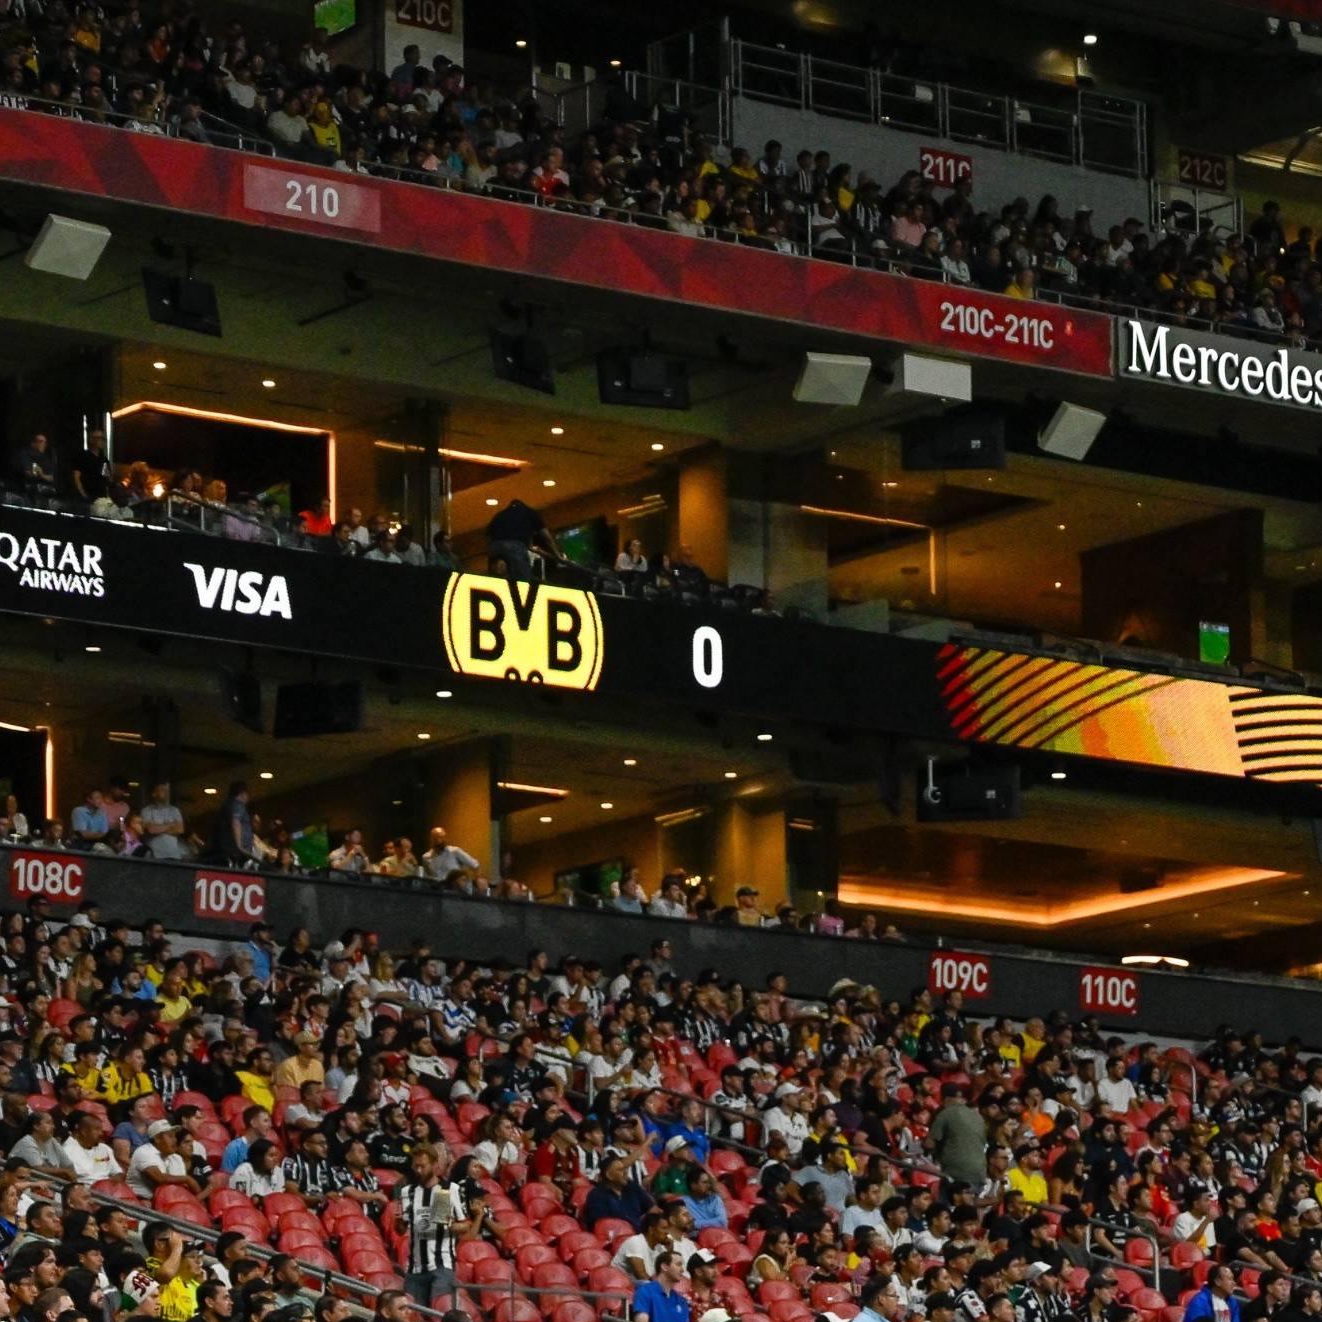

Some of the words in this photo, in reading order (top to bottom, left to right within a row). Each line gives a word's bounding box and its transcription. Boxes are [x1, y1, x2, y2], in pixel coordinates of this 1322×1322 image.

[1181, 156, 1225, 186] 212C
[285, 180, 340, 218] 210
[940, 302, 1054, 350] 210C-211C
[19, 567, 105, 598] AIRWAYS
[183, 562, 293, 620] VISA
[469, 576, 583, 672] BVB
[692, 625, 723, 688] 0
[13, 858, 82, 897] 108C
[195, 878, 264, 916] 109C
[932, 957, 988, 993] 109C
[1082, 974, 1135, 1008] 110C
